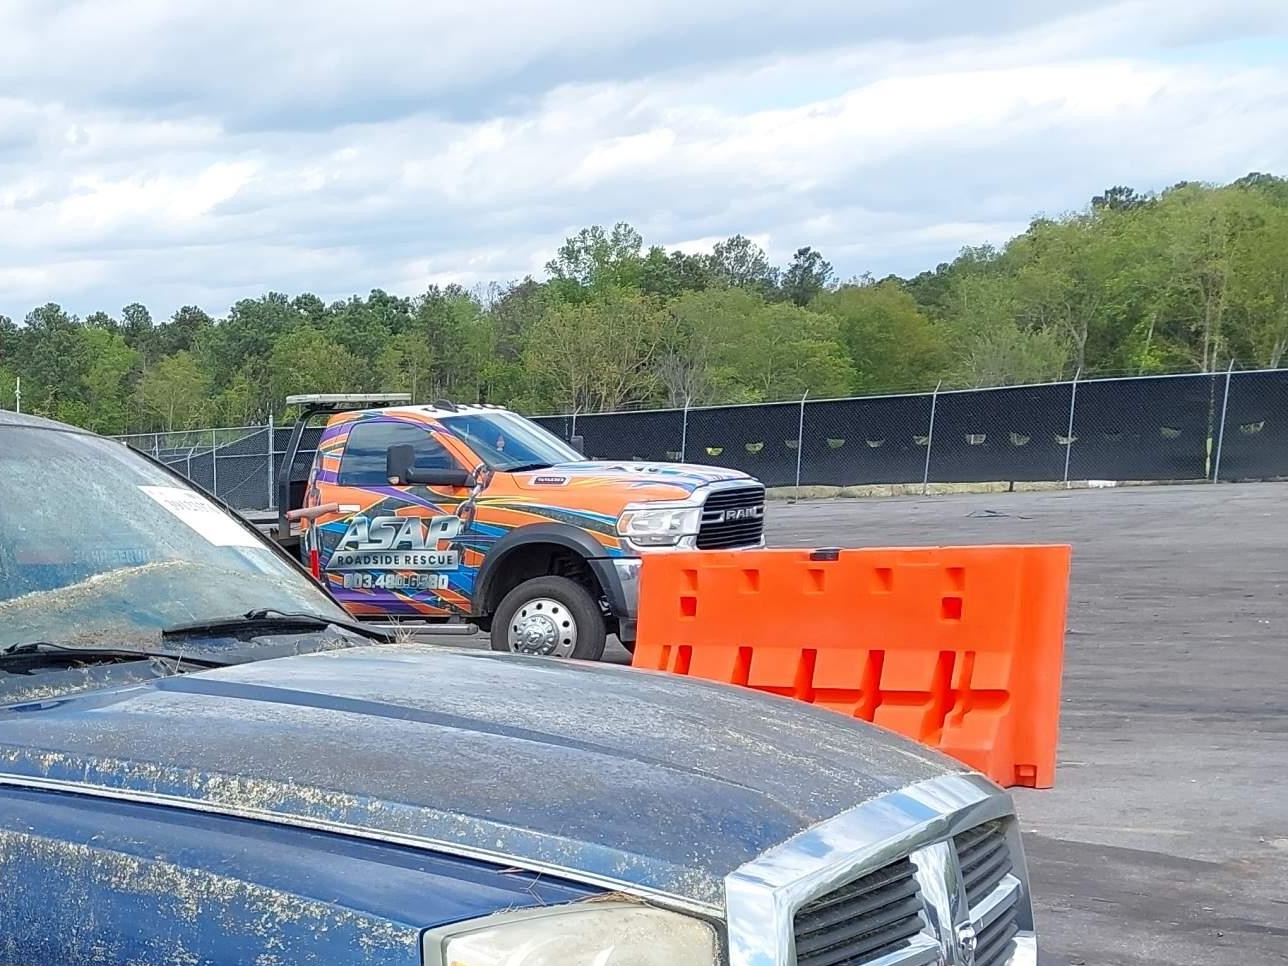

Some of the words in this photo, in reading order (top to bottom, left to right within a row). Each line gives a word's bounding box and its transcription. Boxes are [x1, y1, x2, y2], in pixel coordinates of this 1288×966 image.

[726, 507, 756, 520] RAM
[336, 515, 460, 551] ASAP
[337, 555, 400, 566] ROADSIDE
[404, 555, 453, 566] RESCUE
